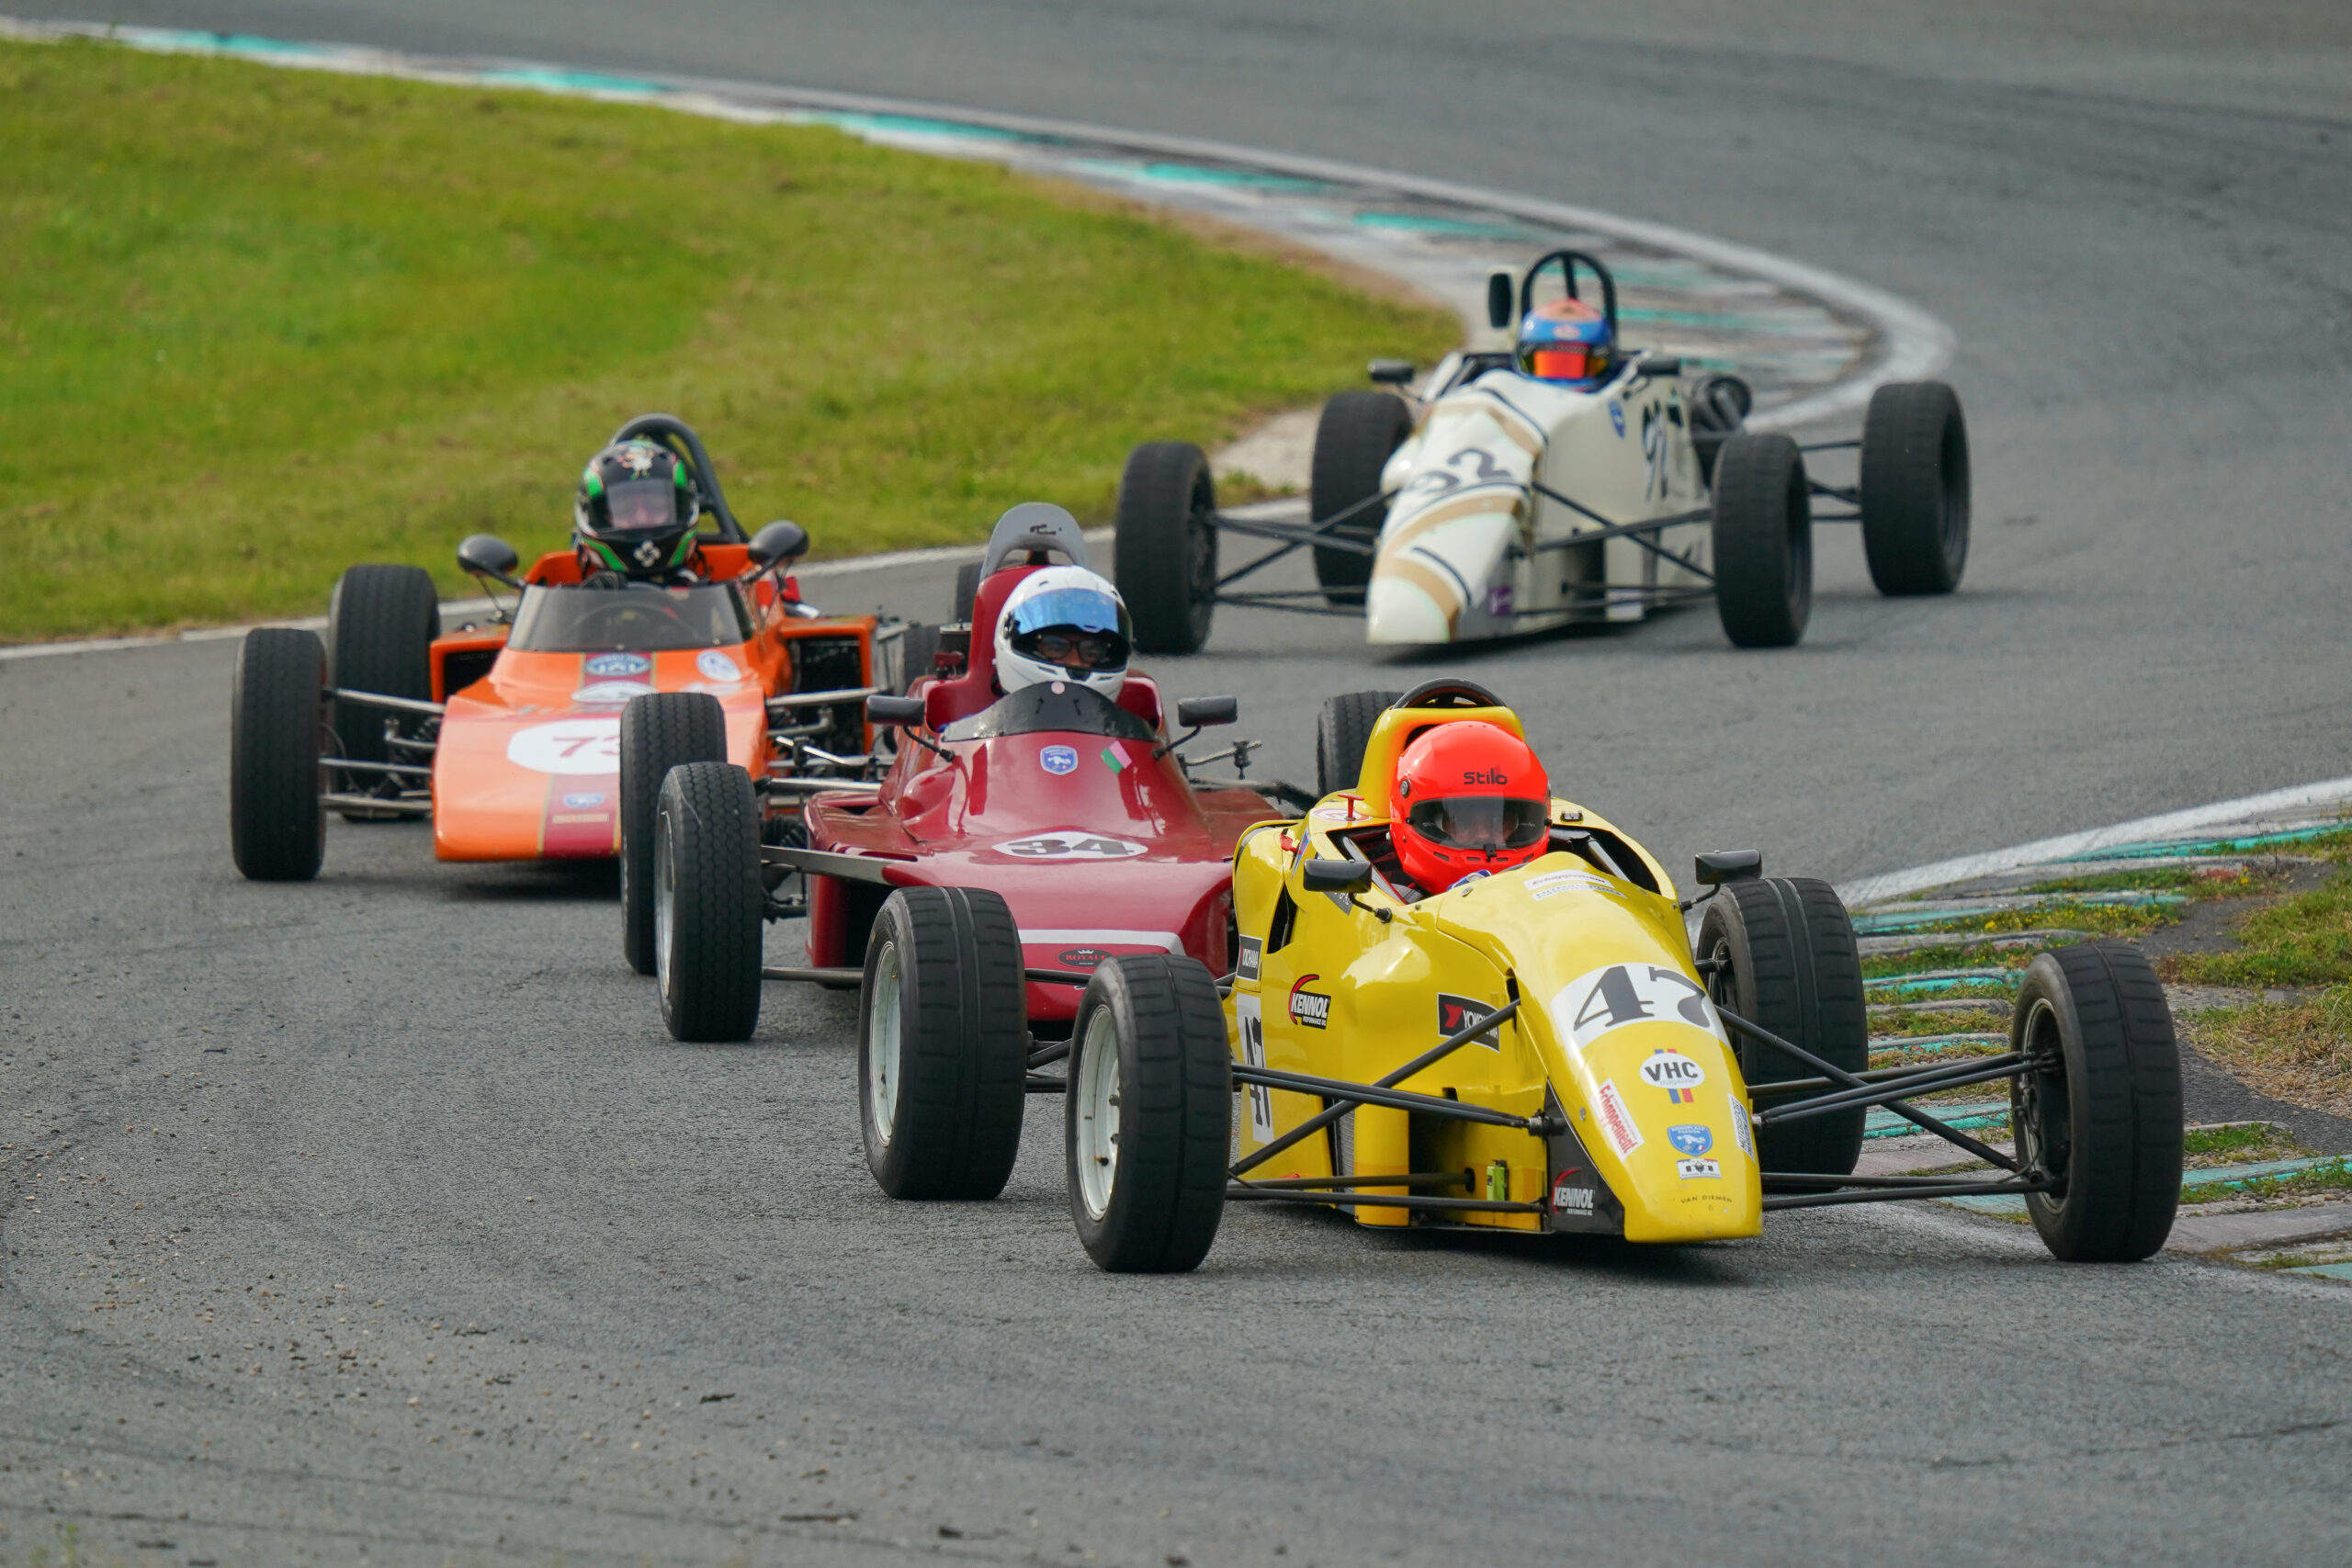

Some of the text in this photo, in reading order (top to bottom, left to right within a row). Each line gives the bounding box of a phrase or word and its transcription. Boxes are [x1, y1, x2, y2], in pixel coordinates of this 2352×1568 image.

[1463, 767, 1508, 785] Stilo
[1007, 839, 1135, 856] 34
[1291, 992, 1329, 1019] KENNOL
[1573, 965, 1711, 1032] 47
[1645, 1061, 1699, 1082] VHC
[1554, 1186, 1595, 1209] KENNOL
[1680, 1194, 1733, 1204] VAN DIEMEN
